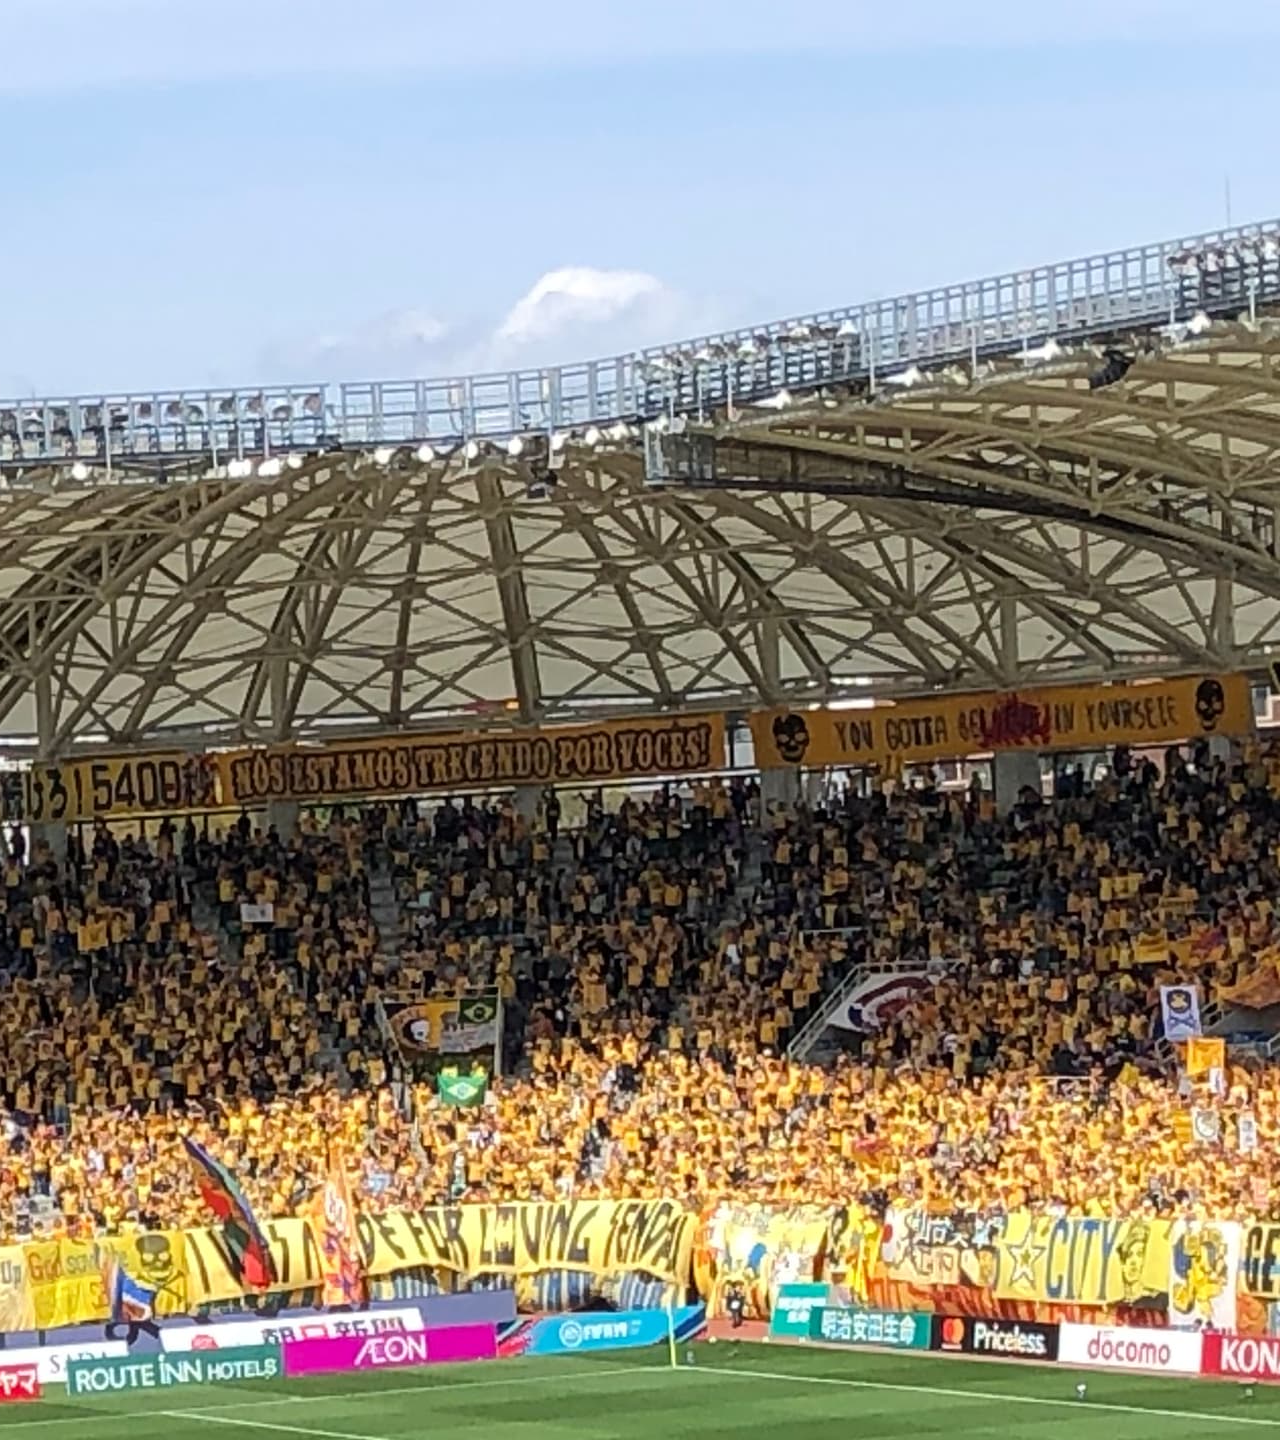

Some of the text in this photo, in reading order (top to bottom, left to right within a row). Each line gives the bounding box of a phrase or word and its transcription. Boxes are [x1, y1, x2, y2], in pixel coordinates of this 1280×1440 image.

[556, 731, 613, 777] POR
[1045, 1217, 1121, 1300] CITY
[820, 1308, 917, 1345] 明治安田生命
[1087, 1329, 1171, 1365] docomo
[74, 1363, 156, 1393] ROUTE
[206, 1357, 278, 1380] HOTELS
